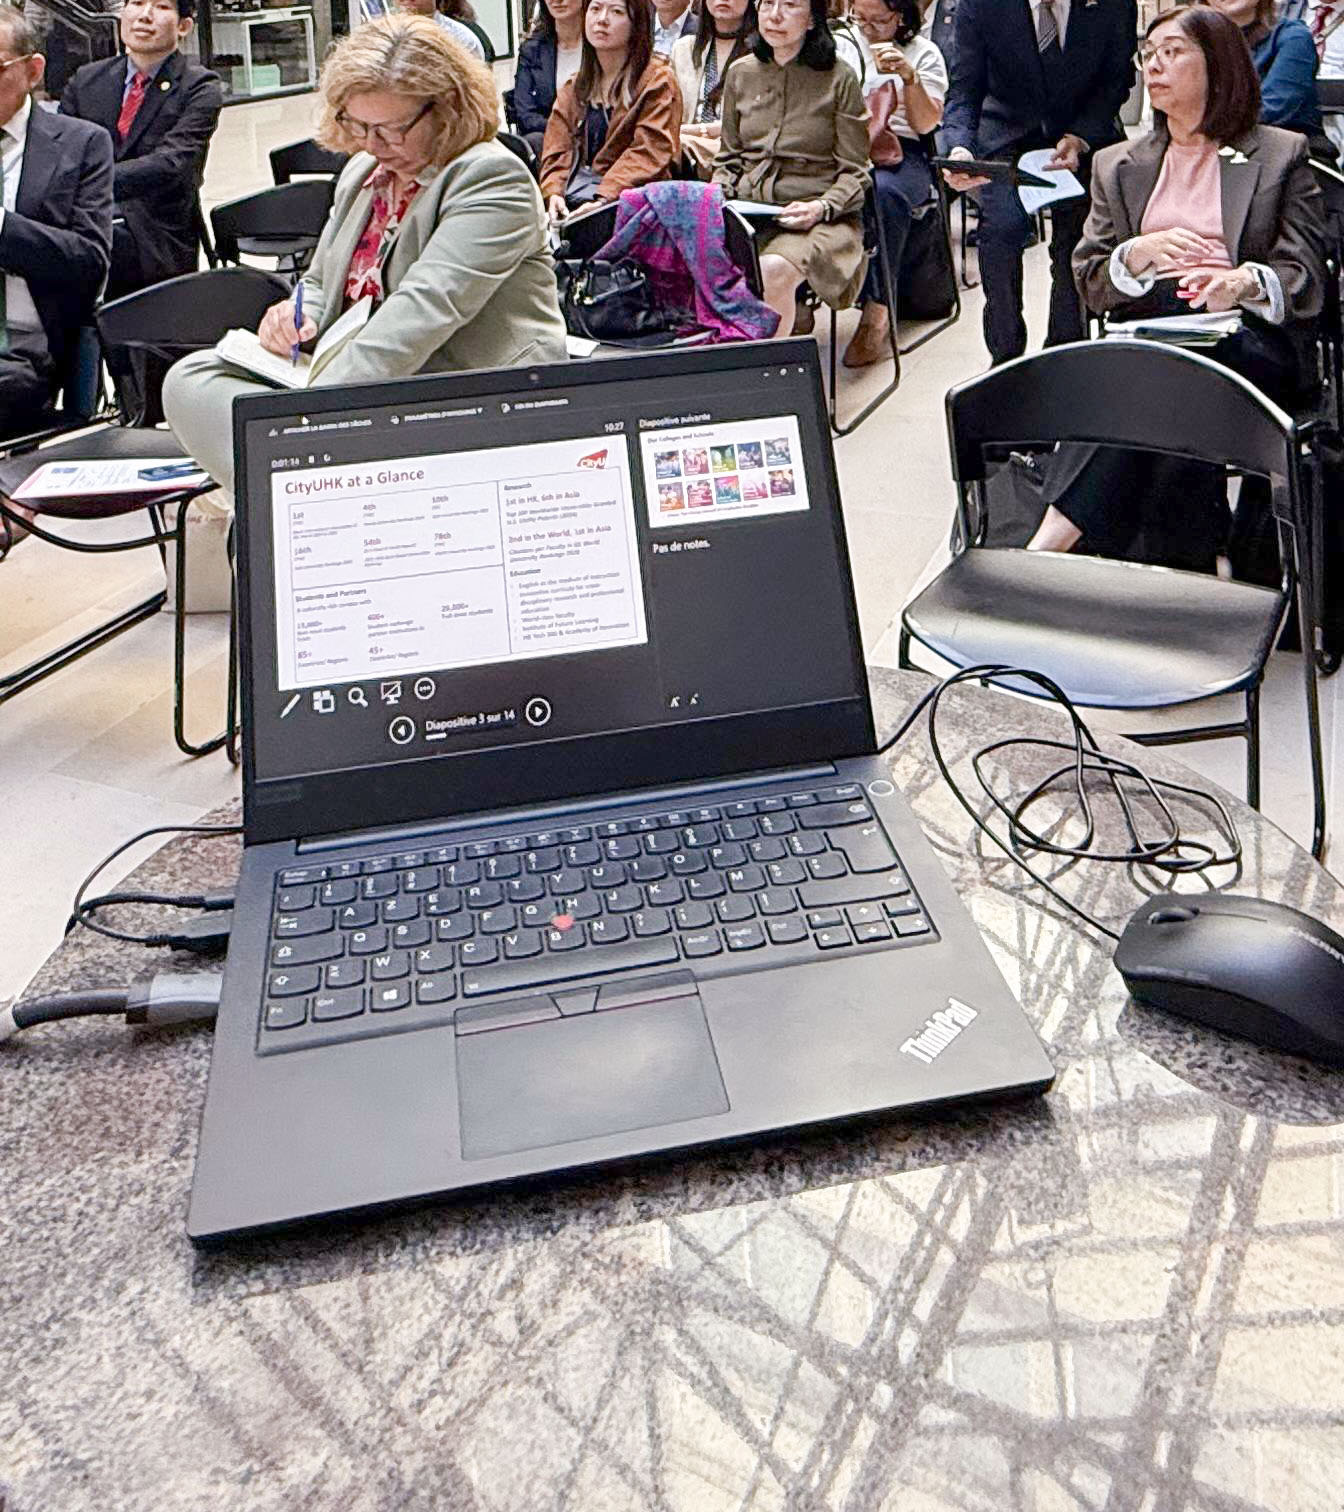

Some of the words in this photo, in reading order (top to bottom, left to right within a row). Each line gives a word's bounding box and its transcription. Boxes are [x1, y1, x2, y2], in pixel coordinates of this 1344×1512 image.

[639, 415, 680, 428] Diapositive
[681, 413, 711, 424] suivante
[285, 476, 343, 495] CityUHK
[347, 476, 360, 487] at
[365, 476, 373, 485] a
[377, 469, 425, 484] Glance
[653, 543, 669, 553] Pas
[670, 541, 682, 551] de
[684, 538, 711, 550] notes.
[426, 716, 477, 732] Diapositive
[479, 715, 486, 725] 3
[487, 714, 502, 723] sur
[504, 709, 515, 721] 14
[713, 849, 722, 857] P
[674, 855, 685, 863] O
[593, 868, 603, 876] U
[731, 871, 743, 880] M
[552, 875, 563, 883] Y
[512, 881, 521, 889] T
[650, 885, 660, 893] K
[429, 894, 437, 902] E
[609, 892, 617, 901] J
[567, 899, 577, 907] H
[344, 908, 355, 916] A
[483, 912, 492, 920] F
[441, 920, 451, 928] D
[593, 922, 604, 931] N
[397, 926, 408, 934] S
[507, 936, 517, 945] V
[551, 932, 561, 941] B
[420, 950, 431, 959] X
[376, 957, 390, 967] W
[899, 997, 978, 1064] ThinkPad
